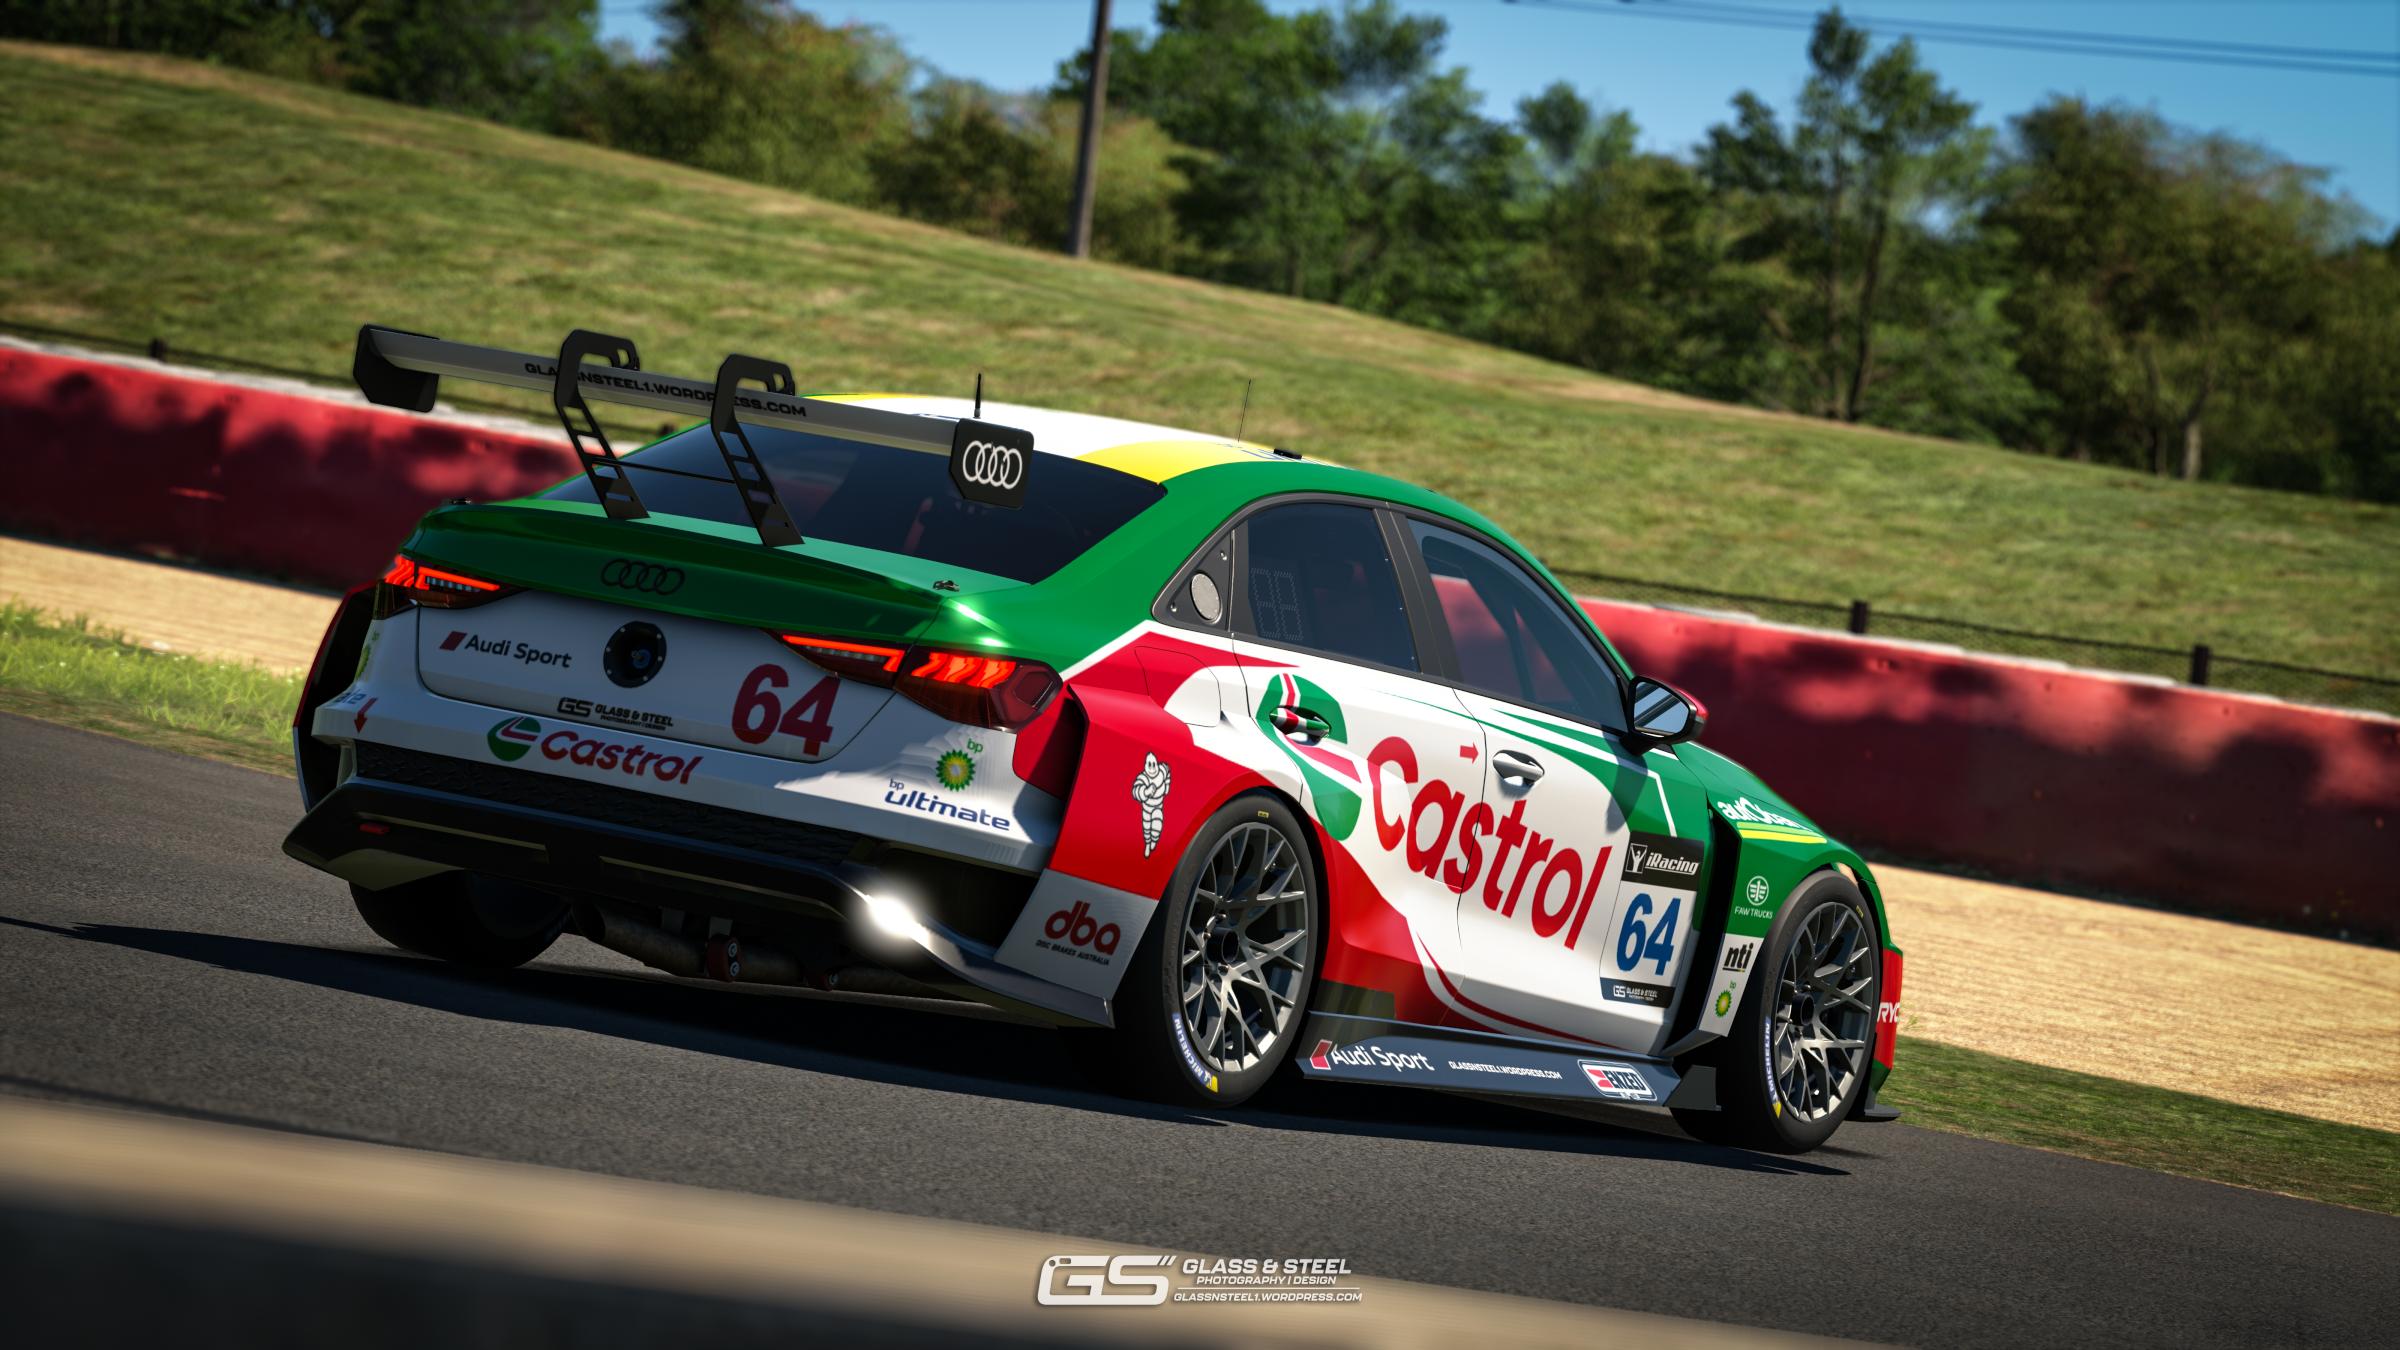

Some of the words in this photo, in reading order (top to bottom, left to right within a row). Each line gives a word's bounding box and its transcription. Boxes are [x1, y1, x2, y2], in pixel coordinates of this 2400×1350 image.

[464, 634, 511, 656] Audi
[514, 643, 572, 668] Sport
[557, 697, 594, 718] GS
[731, 664, 841, 757] 64
[541, 731, 703, 785] Castrol
[967, 738, 984, 754] bp
[889, 779, 905, 791] bp
[884, 790, 1010, 831] ultimate
[1367, 736, 1613, 951] Castrol
[1645, 852, 1700, 876] iRacing
[1734, 906, 1749, 916] FAW
[1750, 908, 1773, 919] TRUCKS
[1044, 901, 1121, 956] dba
[1616, 893, 1682, 976] 64
[1723, 942, 1754, 969] nti
[1613, 985, 1626, 998] GS
[1174, 1018, 1204, 1078] MICHELIN
[1330, 1043, 1376, 1066] Audi
[1370, 1046, 1436, 1073] Sport
[1601, 1069, 1647, 1091] ENZED
